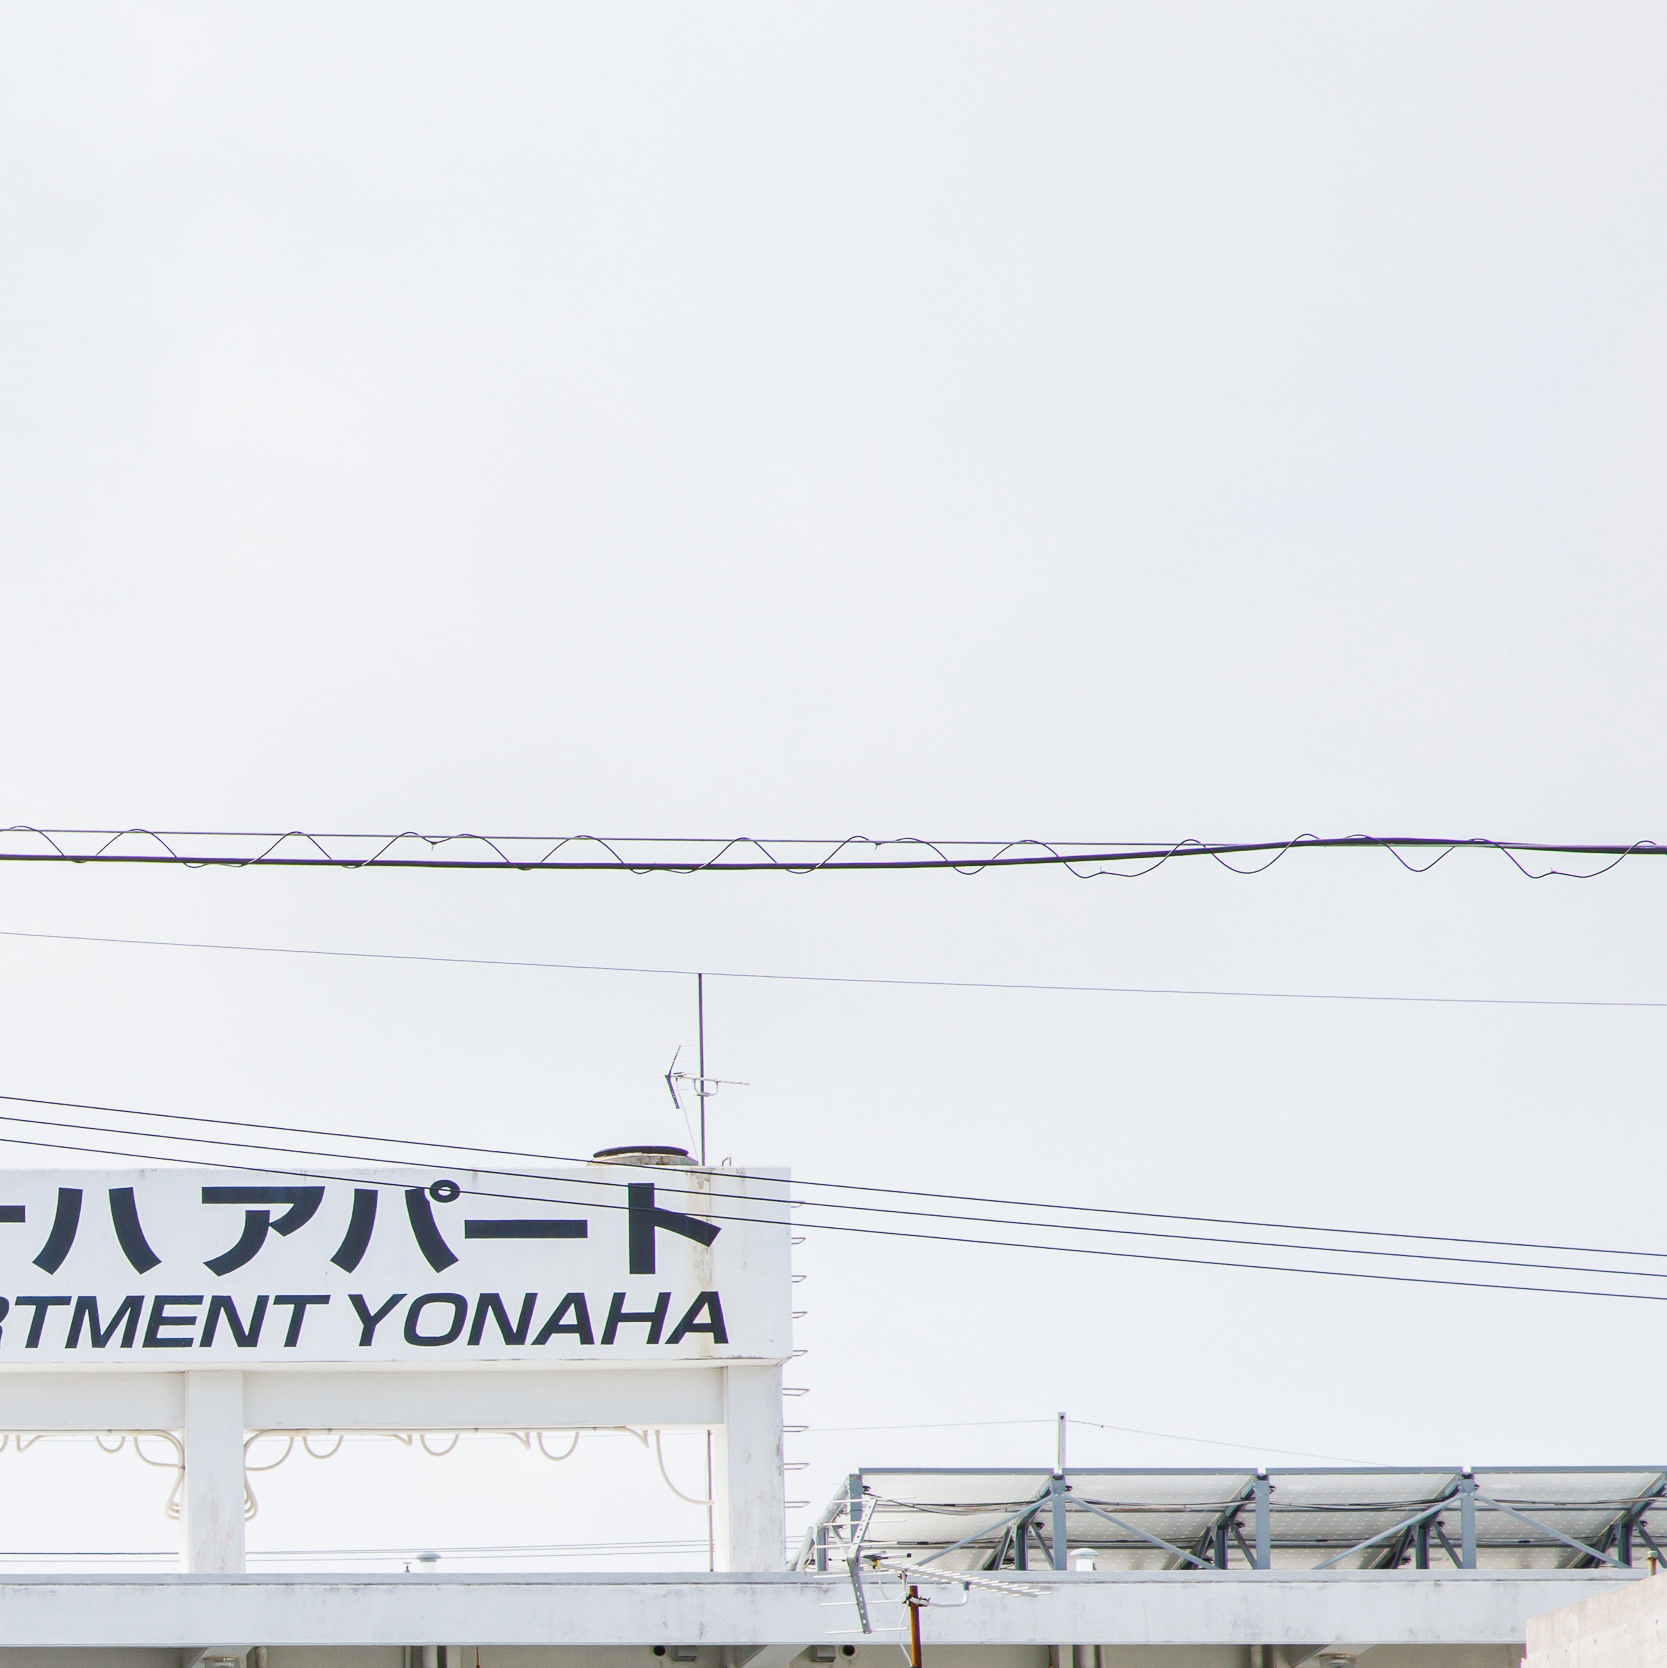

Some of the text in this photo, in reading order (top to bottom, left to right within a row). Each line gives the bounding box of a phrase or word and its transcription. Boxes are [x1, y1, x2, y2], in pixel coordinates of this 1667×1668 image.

[201, 1179, 722, 1276] アパート
[346, 1291, 729, 1348] YONAHA
